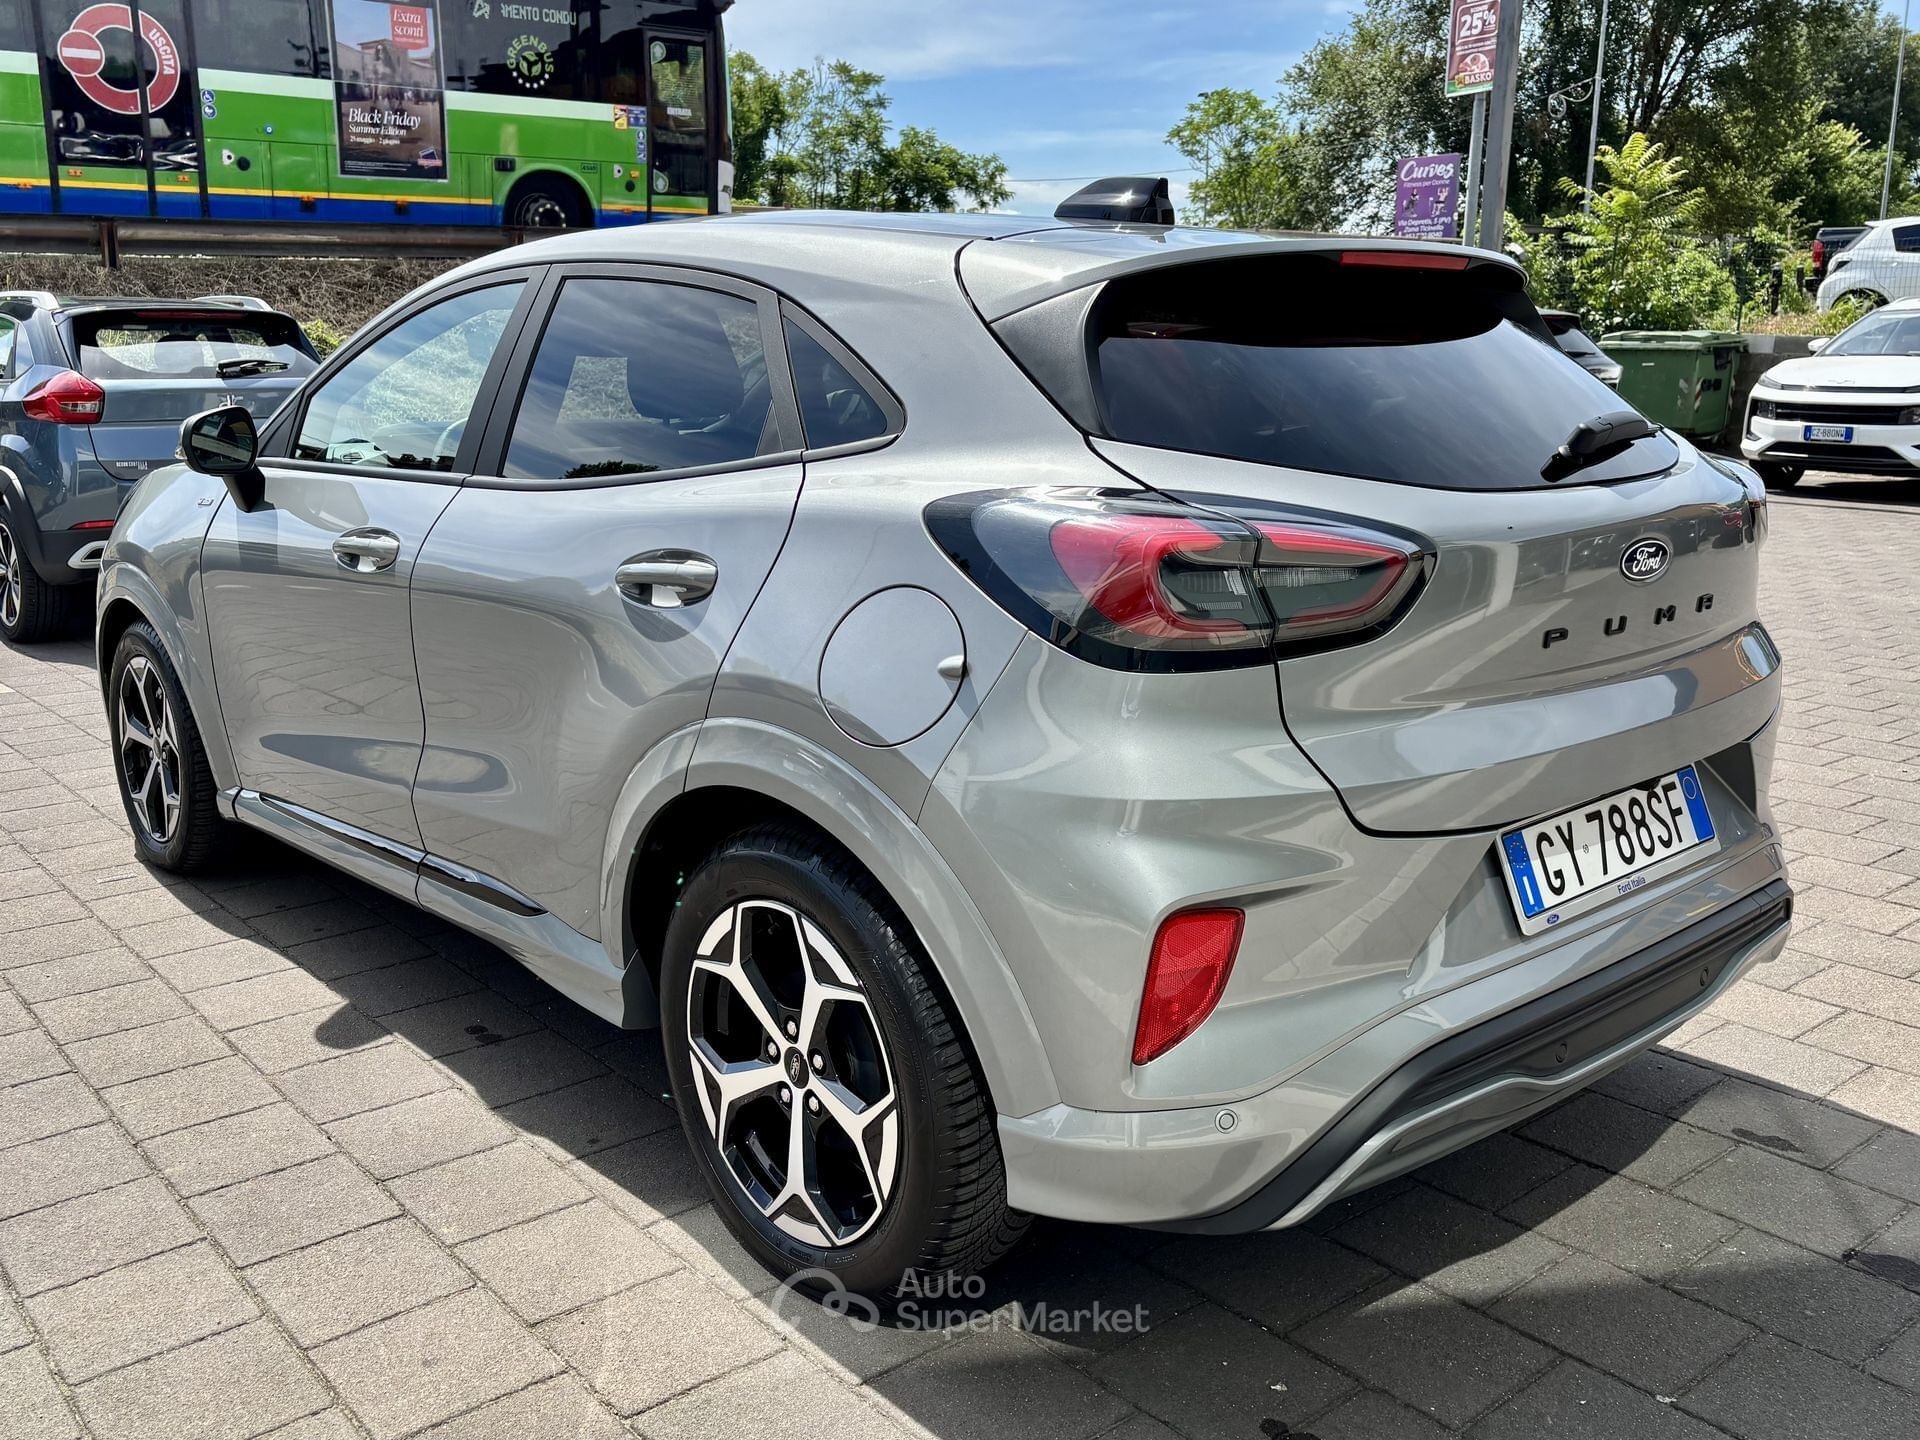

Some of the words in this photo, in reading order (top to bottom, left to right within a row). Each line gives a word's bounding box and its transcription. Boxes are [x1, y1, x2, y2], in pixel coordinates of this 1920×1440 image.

[393, 9, 421, 24] Extra
[1460, 9, 1496, 38] 25%
[394, 25, 424, 38] sconti
[148, 28, 176, 75] USCITA
[1464, 73, 1492, 84] BASKO
[348, 107, 381, 124] Black
[383, 110, 421, 130] Friday
[348, 123, 380, 135] Summer
[380, 125, 407, 136] Edition
[1401, 161, 1454, 181] Curves
[1632, 546, 1663, 573] Ford
[1541, 593, 1714, 649] PUMA
[1617, 882, 1632, 894] Ford
[1631, 875, 1646, 890] Italia
